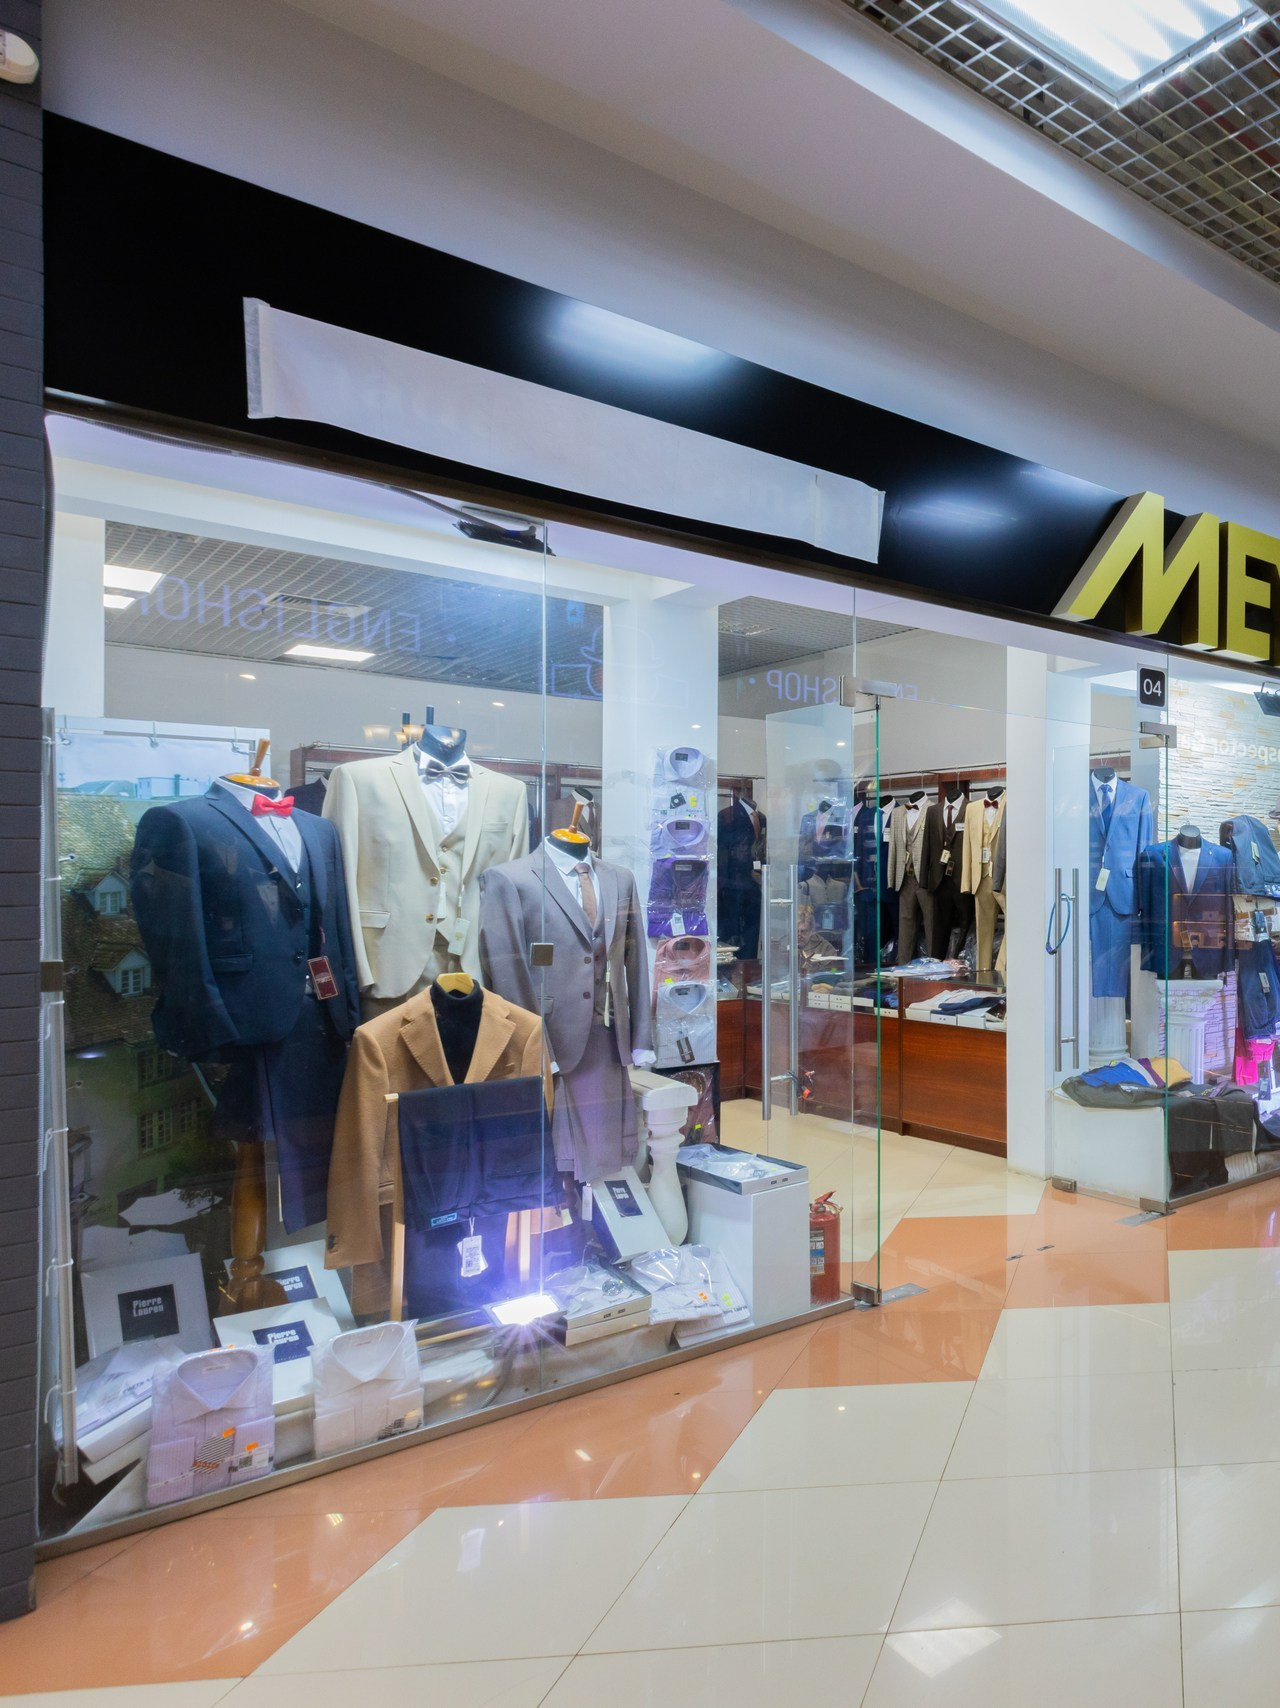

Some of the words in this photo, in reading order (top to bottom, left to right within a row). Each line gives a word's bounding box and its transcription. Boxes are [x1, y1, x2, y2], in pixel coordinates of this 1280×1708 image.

[1143, 678, 1162, 697] 04
[132, 1296, 162, 1309] Pierre
[132, 1304, 164, 1318] Lauren
[267, 1329, 297, 1341] Pierre
